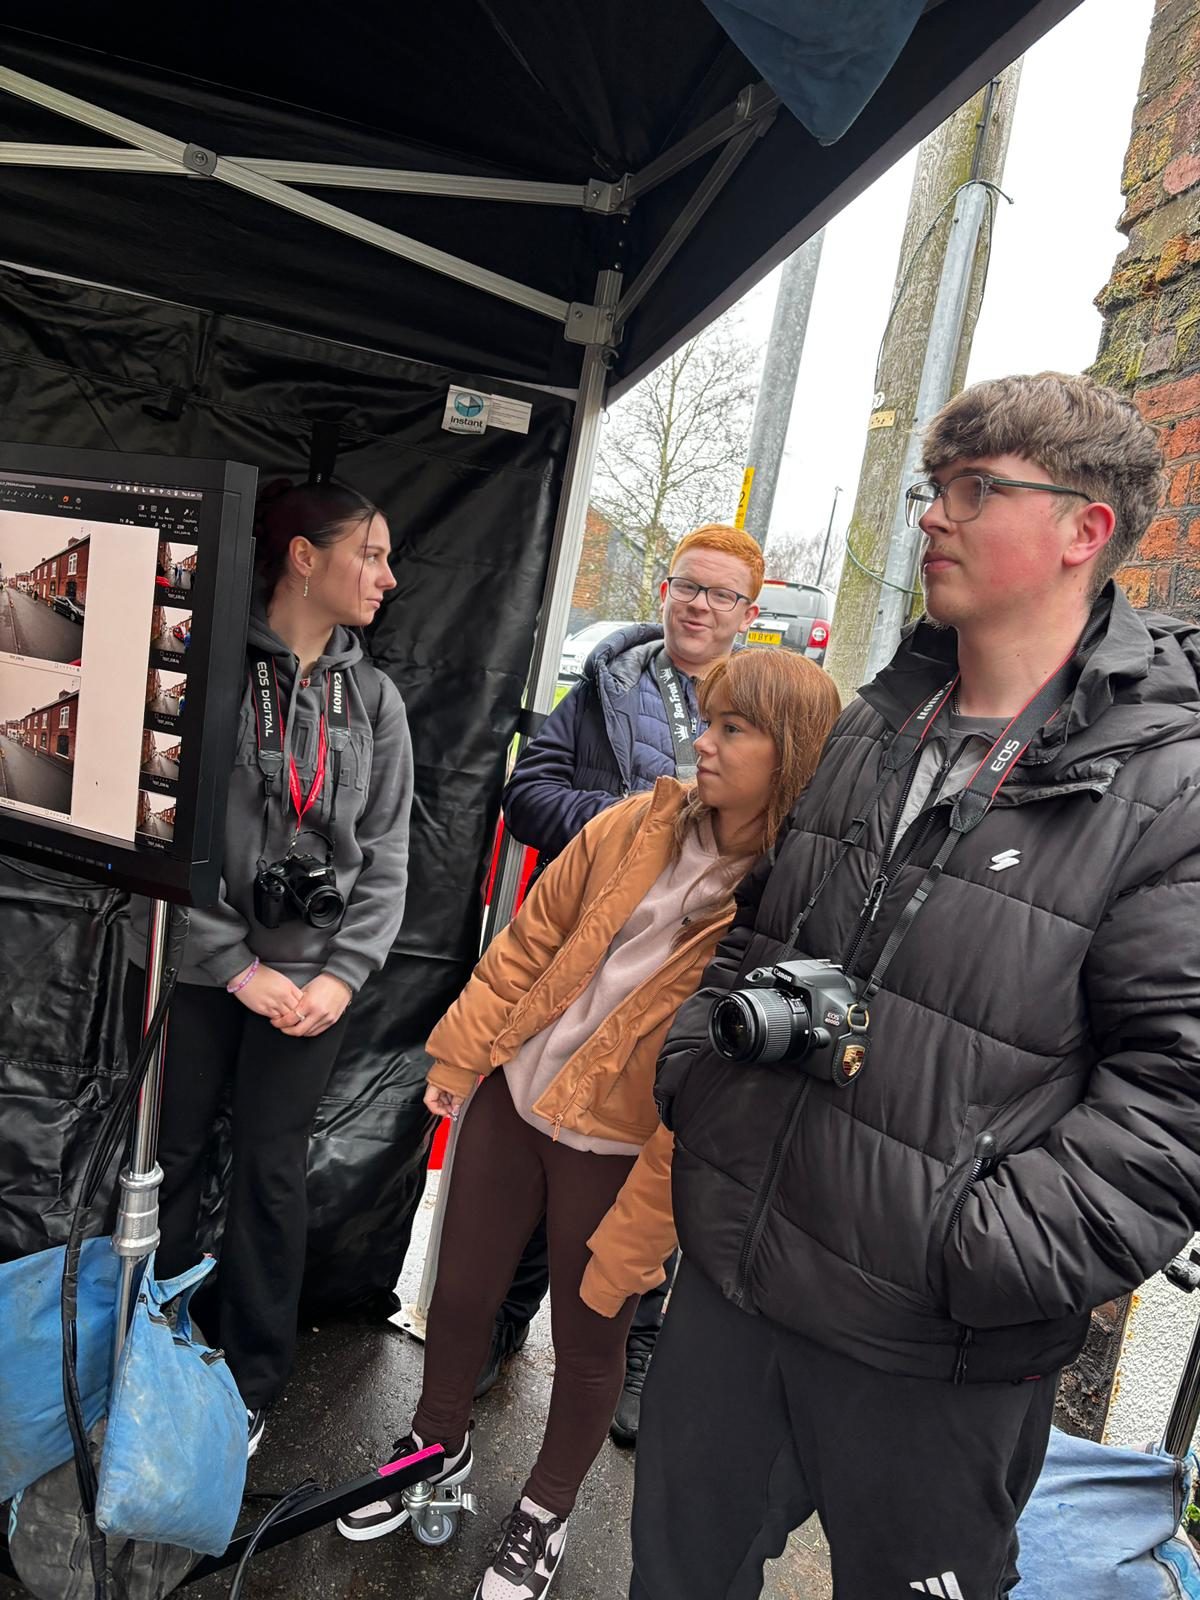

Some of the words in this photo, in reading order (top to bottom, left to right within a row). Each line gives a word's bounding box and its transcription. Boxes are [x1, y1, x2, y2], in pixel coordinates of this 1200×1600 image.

[257, 661, 269, 687] EOS
[333, 672, 342, 714] Canon
[261, 689, 273, 738] DIGITAL
[990, 738, 1021, 773] EOS
[773, 967, 792, 983] Canon
[827, 1012, 840, 1021] EOS
